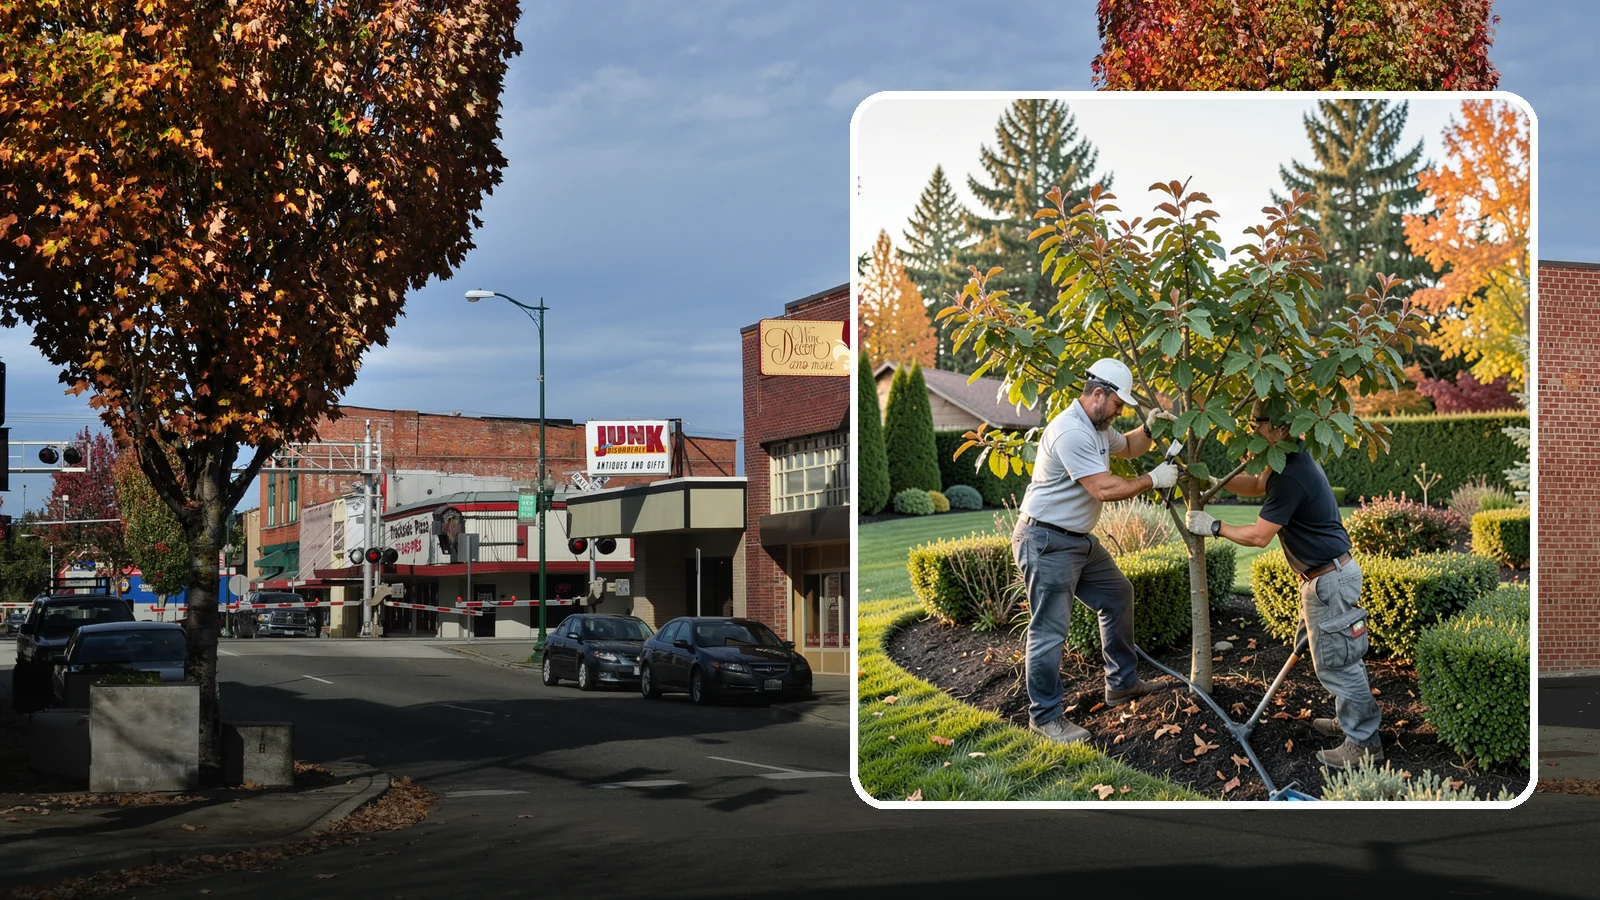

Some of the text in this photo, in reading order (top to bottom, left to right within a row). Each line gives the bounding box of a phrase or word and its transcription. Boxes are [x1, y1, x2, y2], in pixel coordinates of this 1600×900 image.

[595, 425, 665, 457] JUNK
[607, 446, 645, 454] DISORDERLY
[596, 460, 665, 469] ANTIQUES AND GIFTS
[414, 519, 429, 535] Pizza
